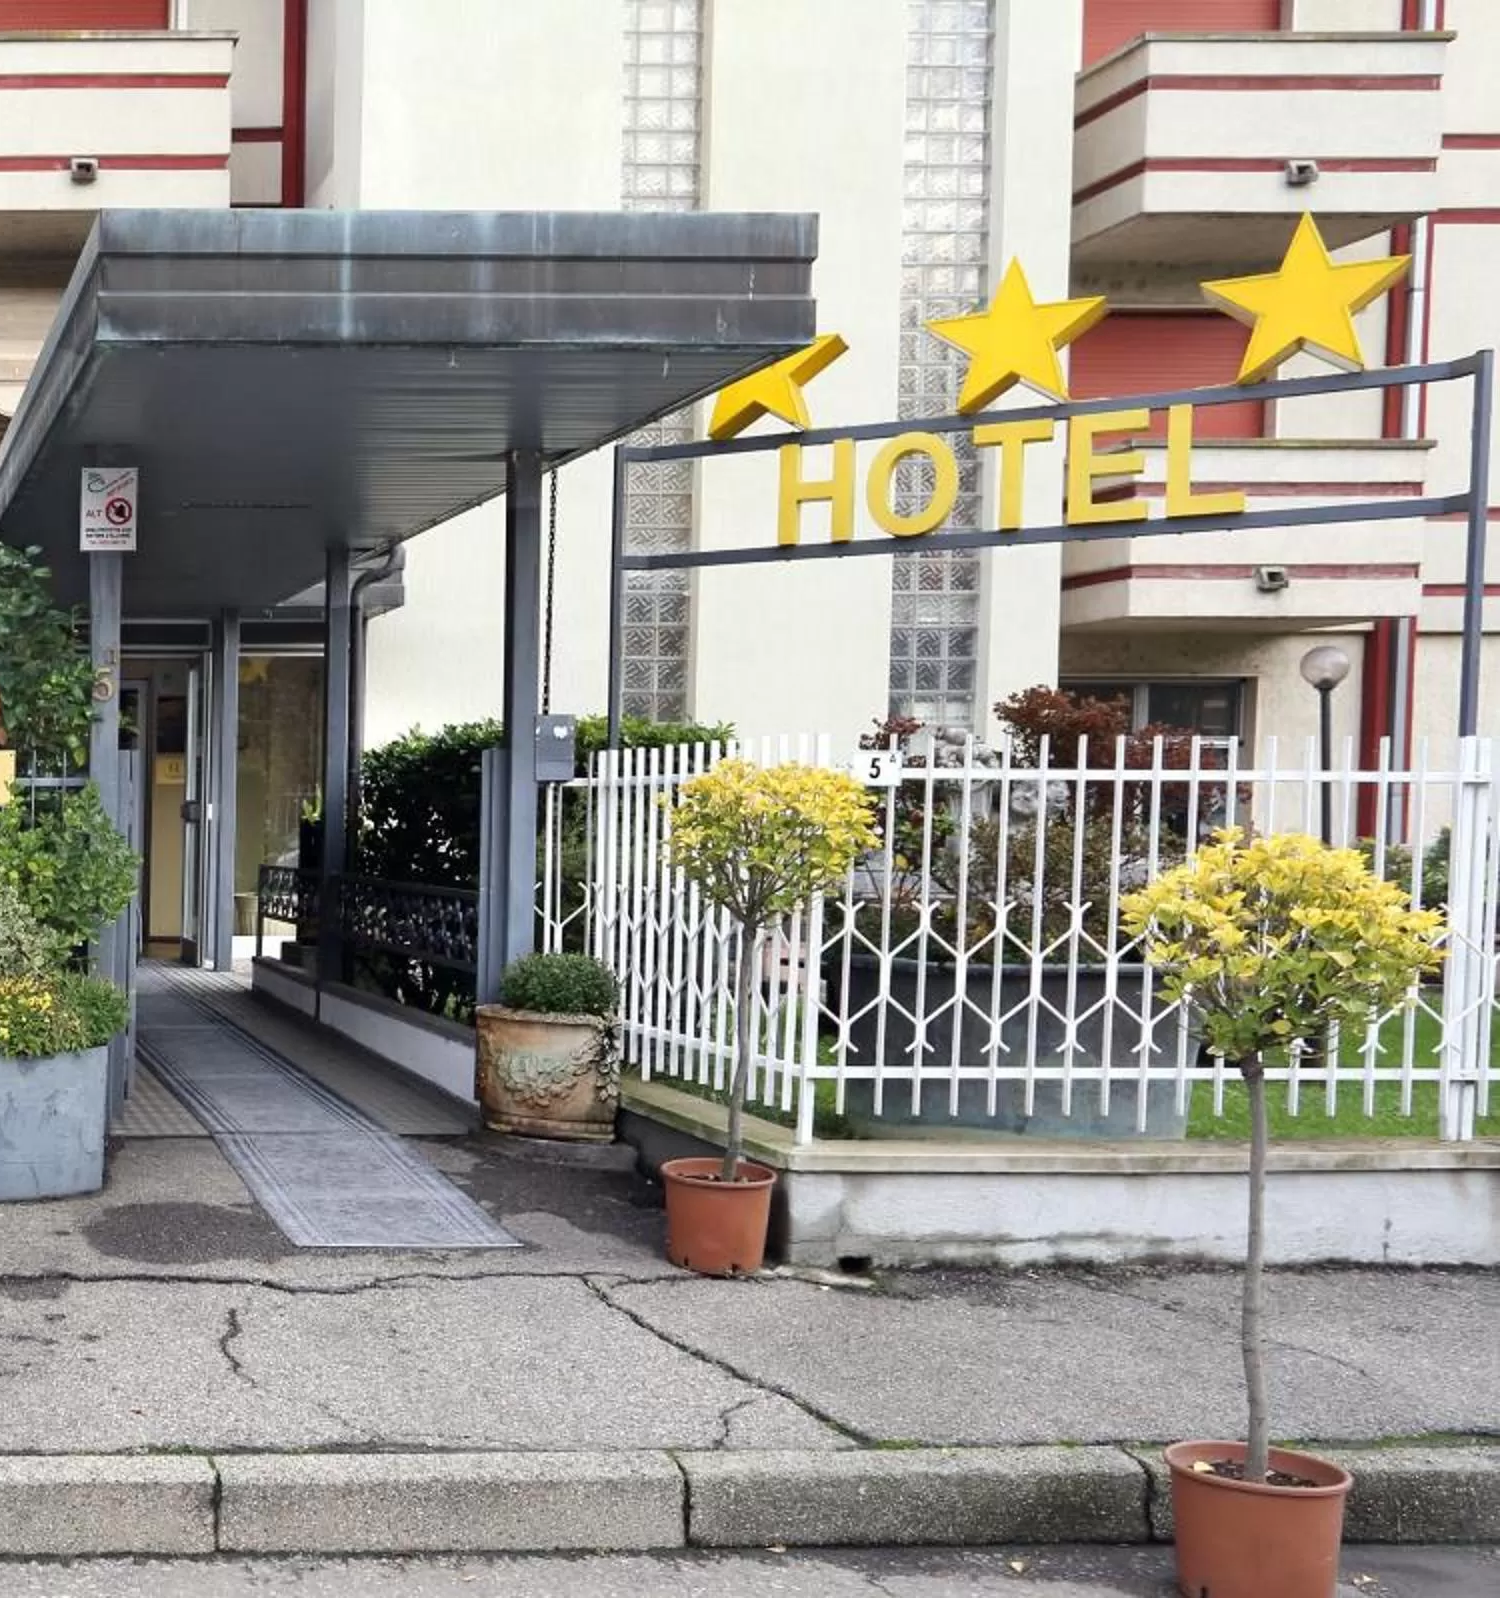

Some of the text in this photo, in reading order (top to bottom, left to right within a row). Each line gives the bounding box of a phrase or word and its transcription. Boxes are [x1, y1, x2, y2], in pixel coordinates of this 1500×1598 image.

[777, 404, 1246, 546] HOTEL
[91, 665, 113, 702] 5
[869, 757, 881, 779] 5
